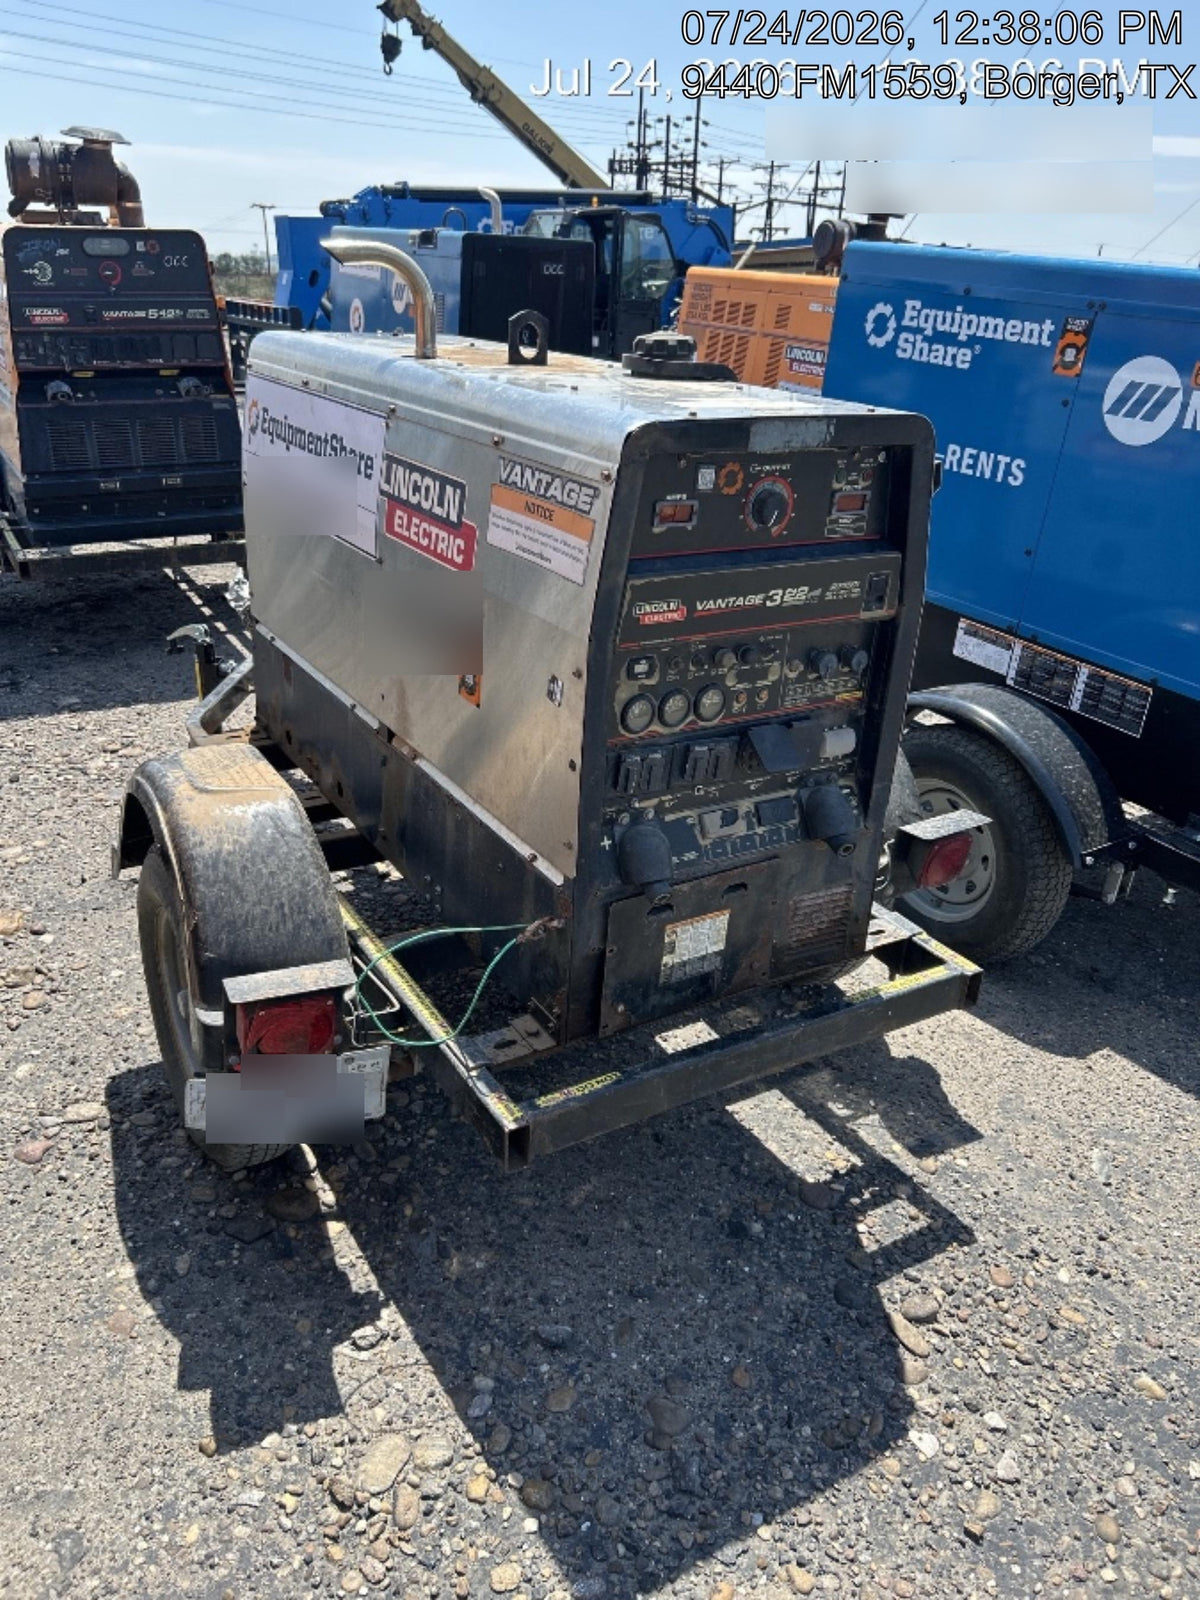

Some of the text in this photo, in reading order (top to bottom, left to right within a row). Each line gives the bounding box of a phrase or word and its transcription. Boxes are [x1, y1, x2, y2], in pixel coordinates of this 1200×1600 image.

[901, 300, 1055, 347] Equipment
[380, 459, 462, 524] LINCOLN
[499, 458, 595, 515] VANTAGE
[524, 500, 555, 521] NOTICE
[394, 509, 465, 564] ELECTRIC
[695, 593, 764, 611] VANTAGE
